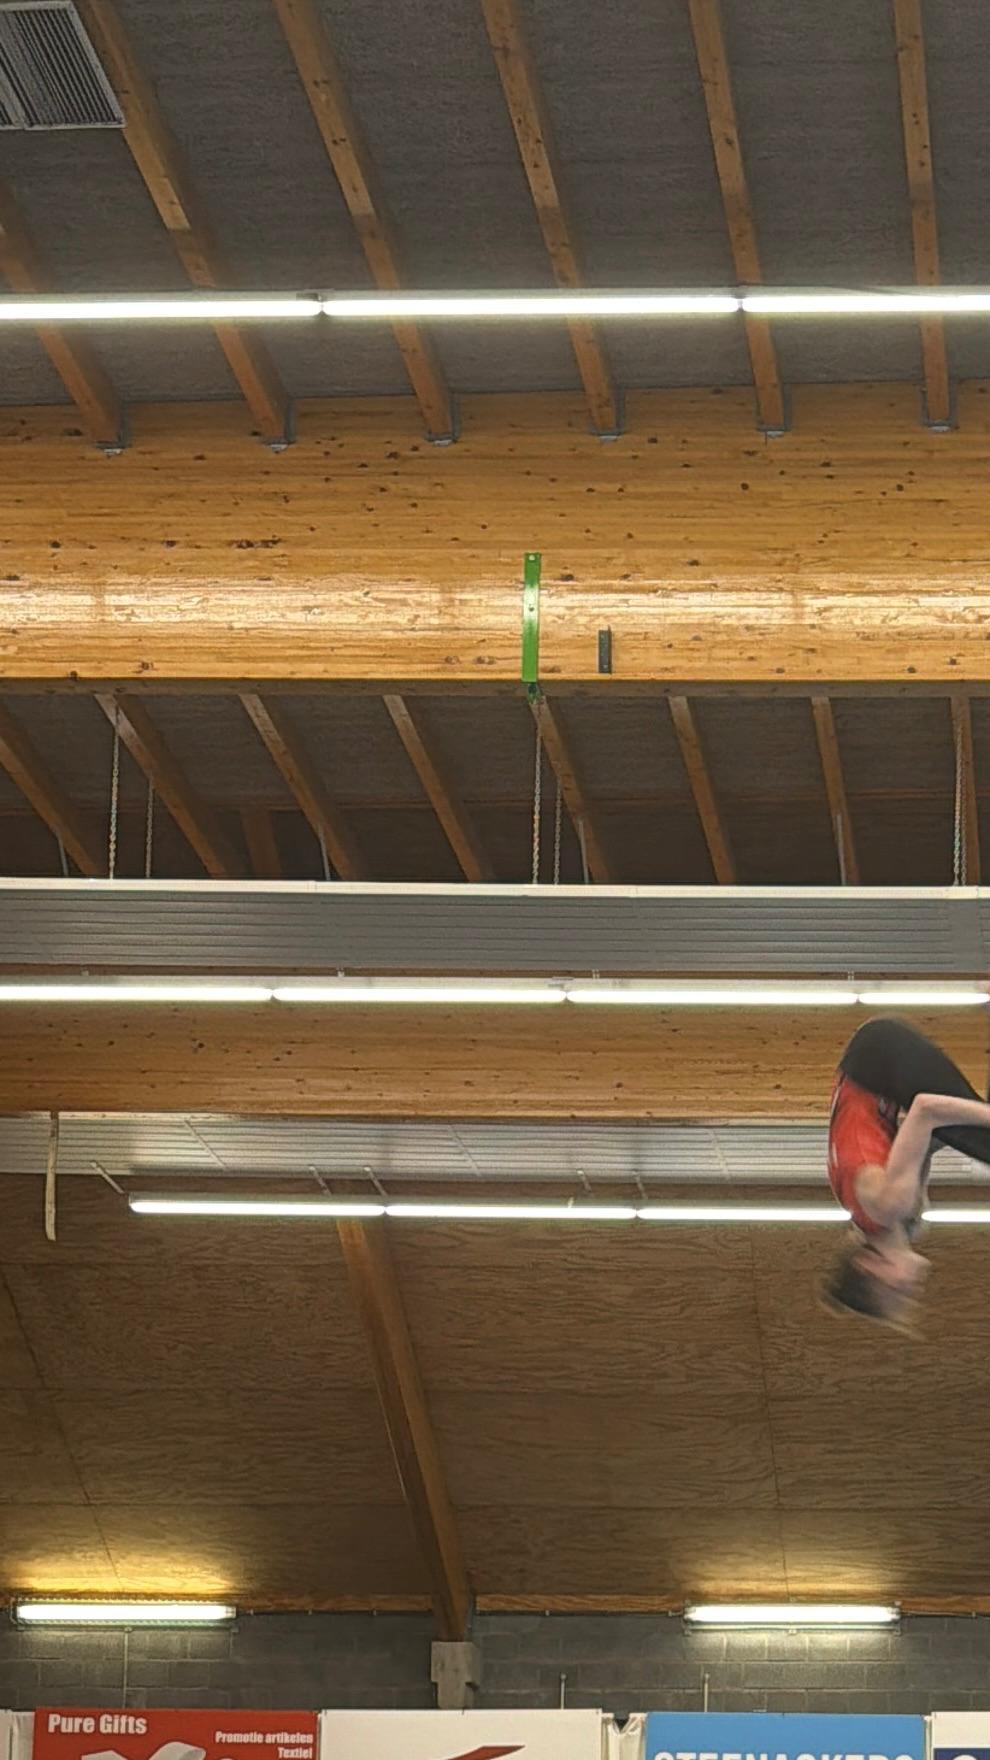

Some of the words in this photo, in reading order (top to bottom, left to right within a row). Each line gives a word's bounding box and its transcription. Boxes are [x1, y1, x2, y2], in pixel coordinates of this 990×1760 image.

[48, 1714, 95, 1733] Pure
[100, 1714, 147, 1733] Gifts
[215, 1731, 264, 1744] Promotie
[277, 1746, 313, 1759] Textiel
